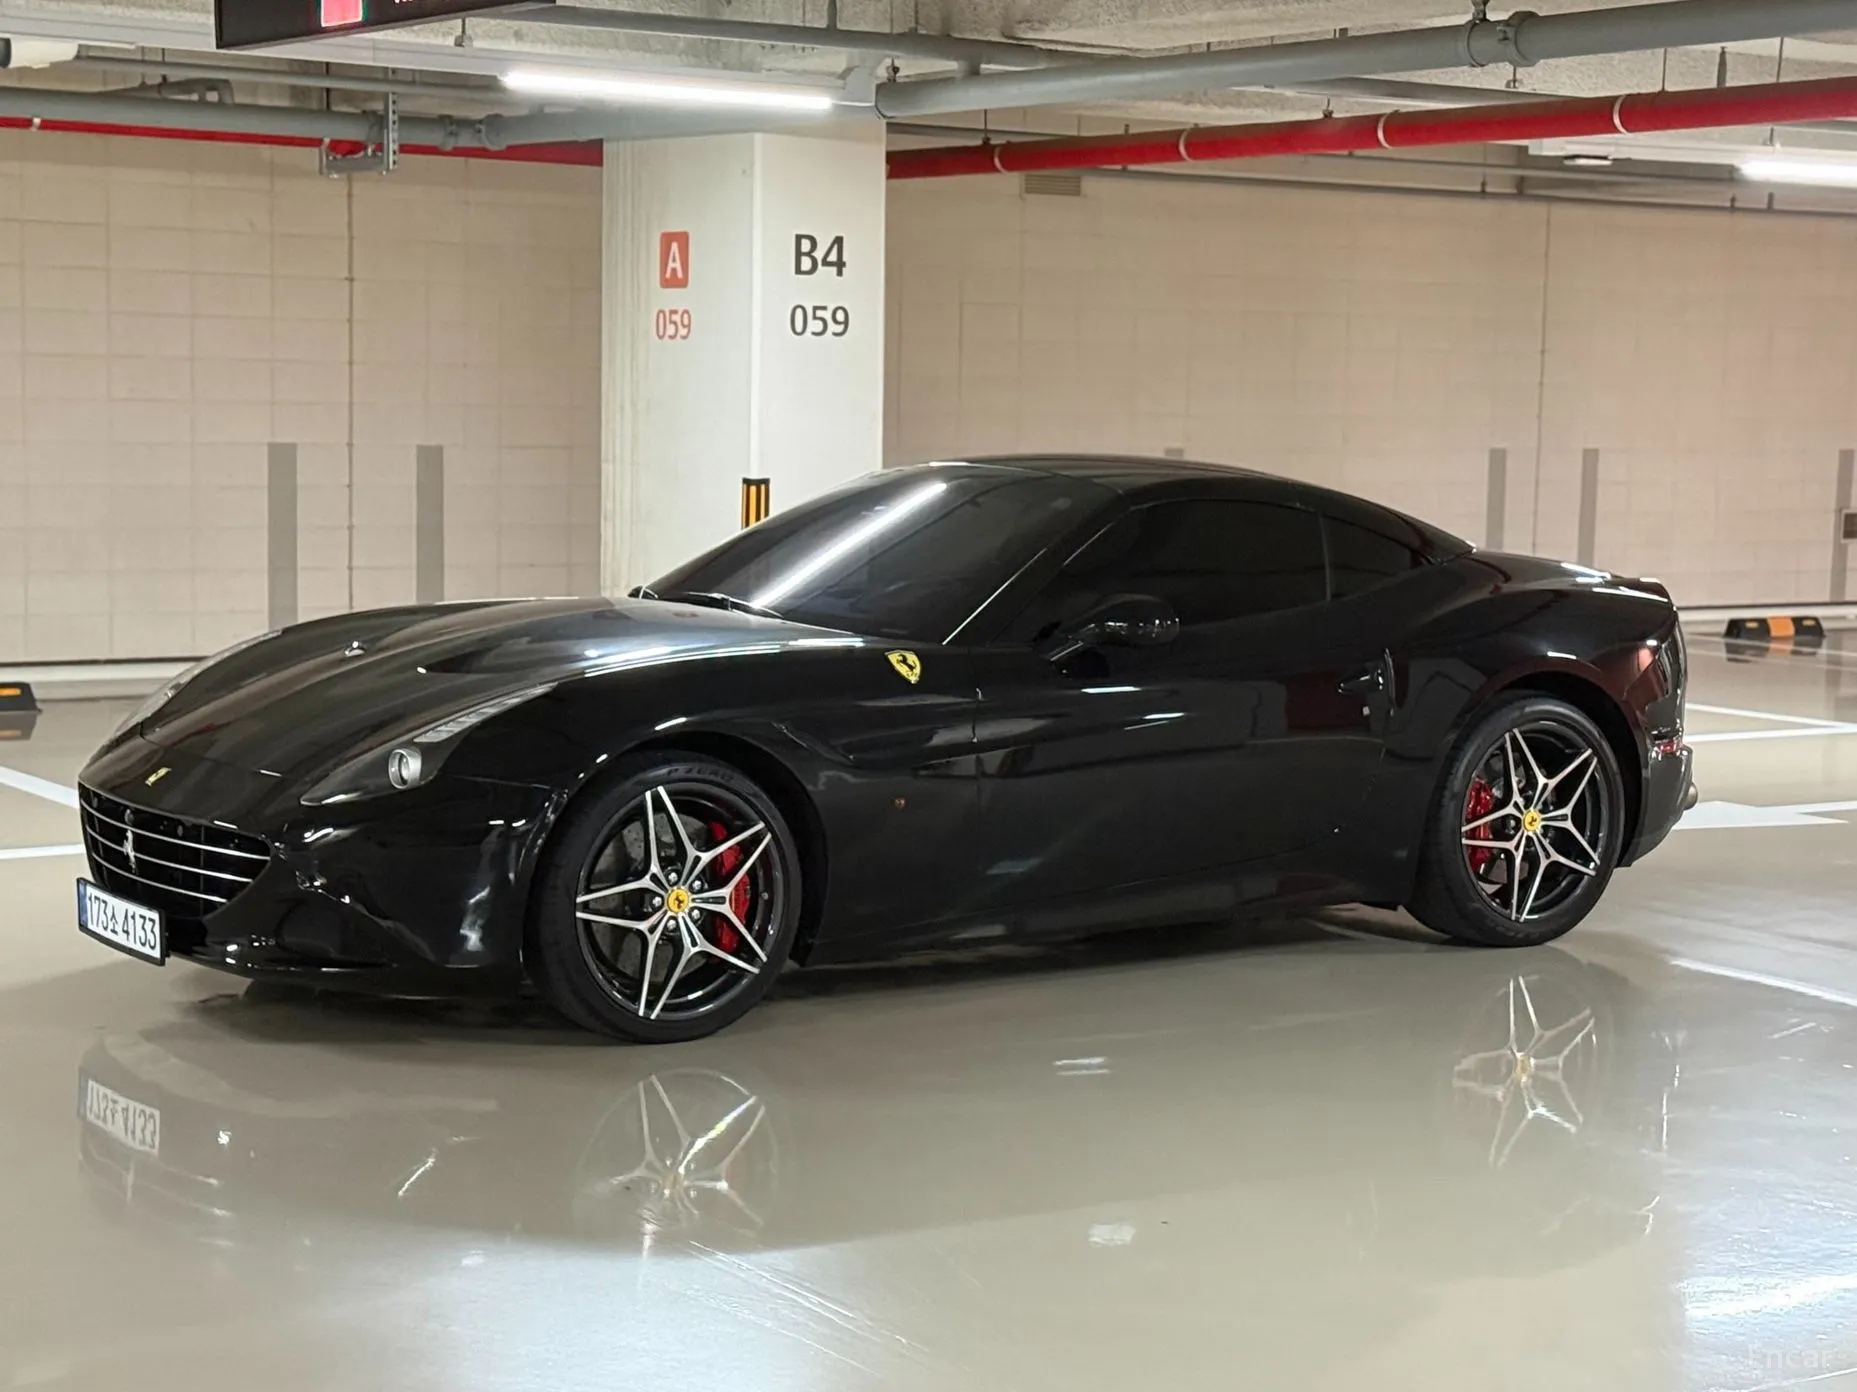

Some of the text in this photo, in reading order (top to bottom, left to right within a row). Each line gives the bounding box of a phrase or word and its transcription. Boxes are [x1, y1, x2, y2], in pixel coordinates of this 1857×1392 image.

[665, 241, 683, 279] A
[795, 234, 846, 276] B4
[656, 309, 691, 340] 059
[790, 304, 849, 337] 059
[122, 908, 157, 950] 4133
